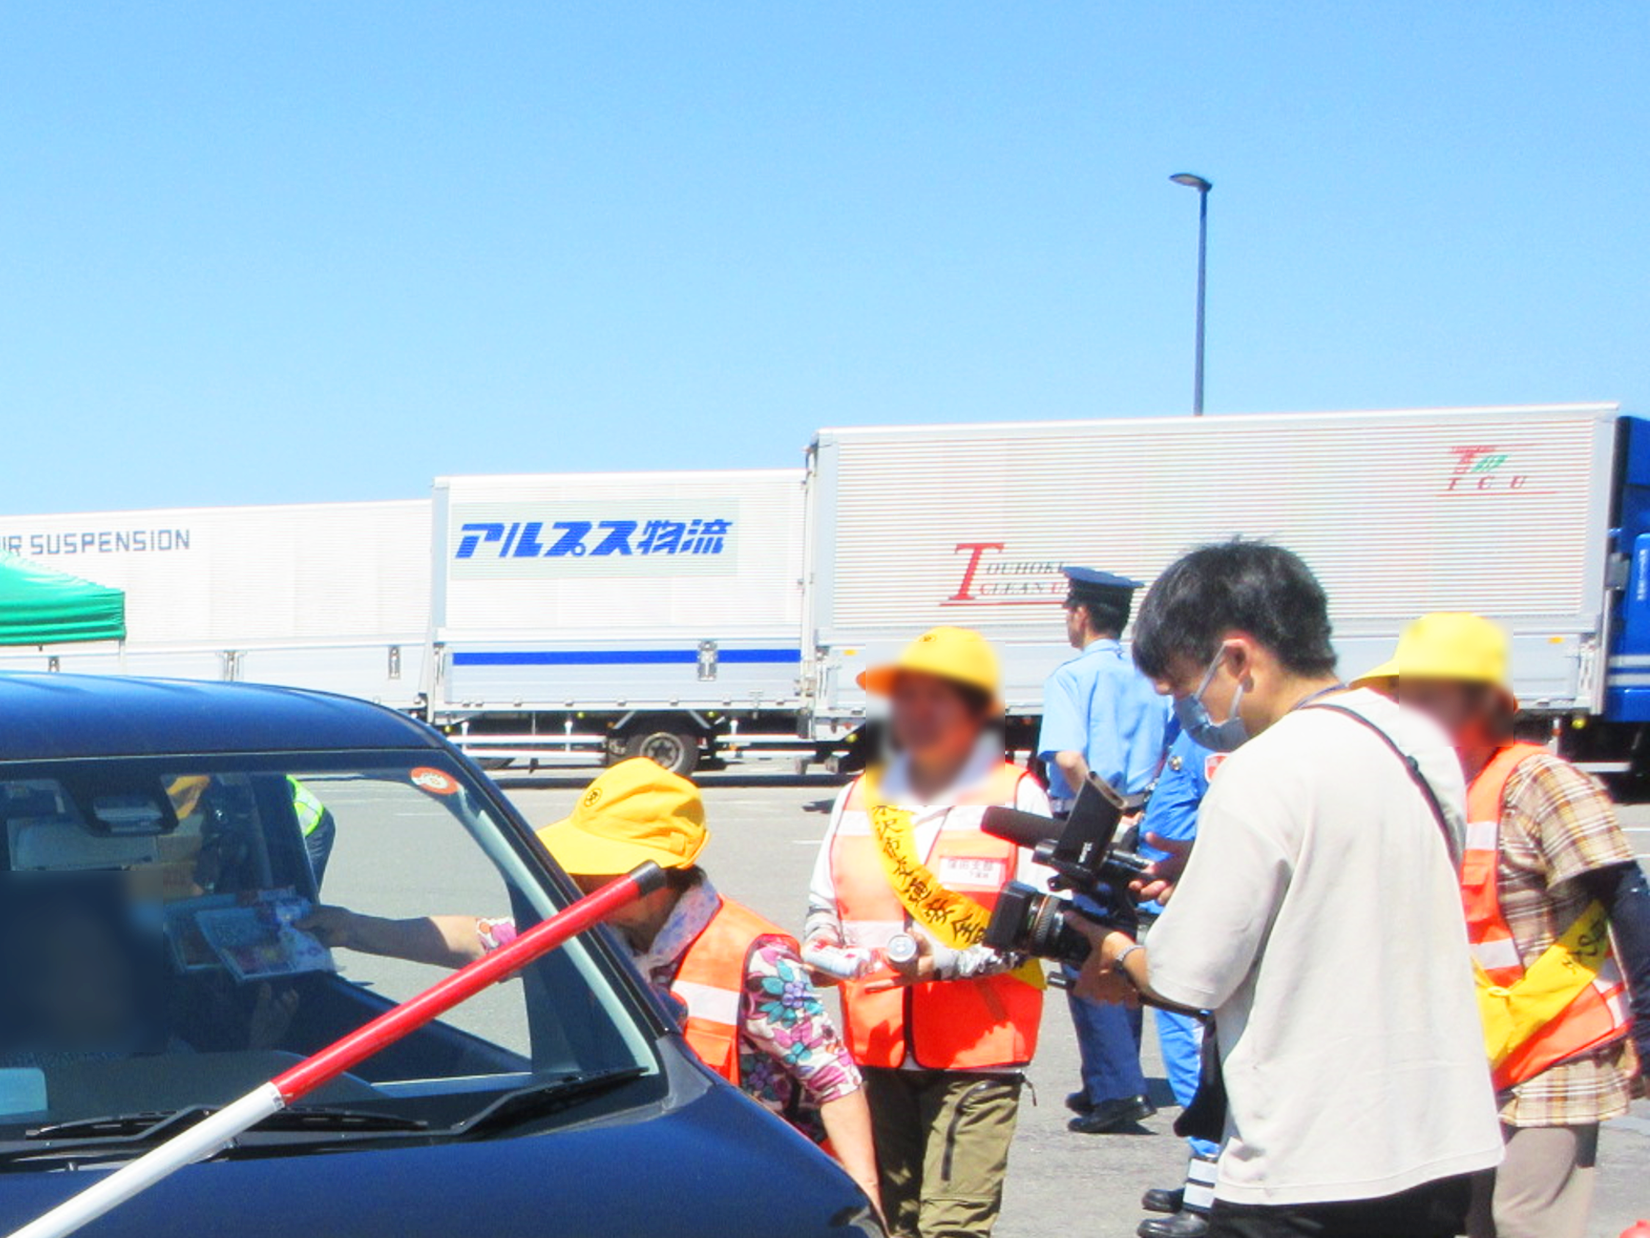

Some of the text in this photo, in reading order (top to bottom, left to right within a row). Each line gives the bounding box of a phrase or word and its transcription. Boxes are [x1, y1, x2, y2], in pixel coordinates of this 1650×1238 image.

[30, 529, 190, 555] SUSPENSION
[455, 519, 733, 558] アルプス物流
